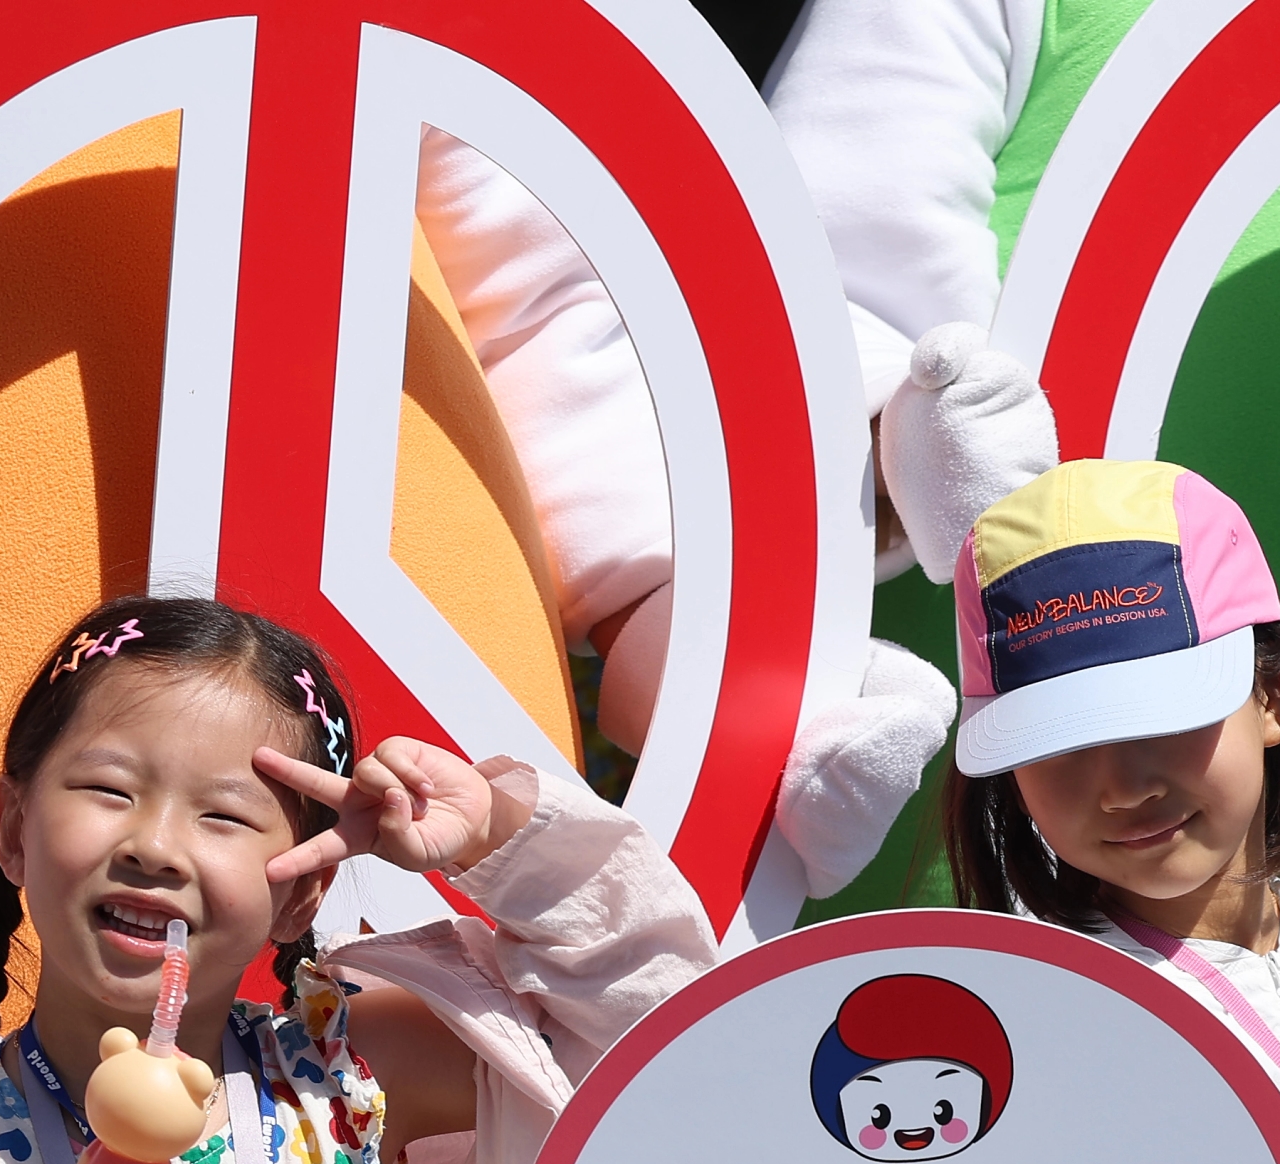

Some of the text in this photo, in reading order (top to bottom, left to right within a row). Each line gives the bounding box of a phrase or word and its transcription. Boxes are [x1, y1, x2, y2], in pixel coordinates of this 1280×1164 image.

[1008, 640, 1026, 652] OUR
[1028, 629, 1053, 645] STORY
[1056, 619, 1091, 635] BEGINS
[1092, 617, 1103, 626] IN
[1105, 610, 1146, 624] BOSTON
[26, 1049, 61, 1091] Eworld
